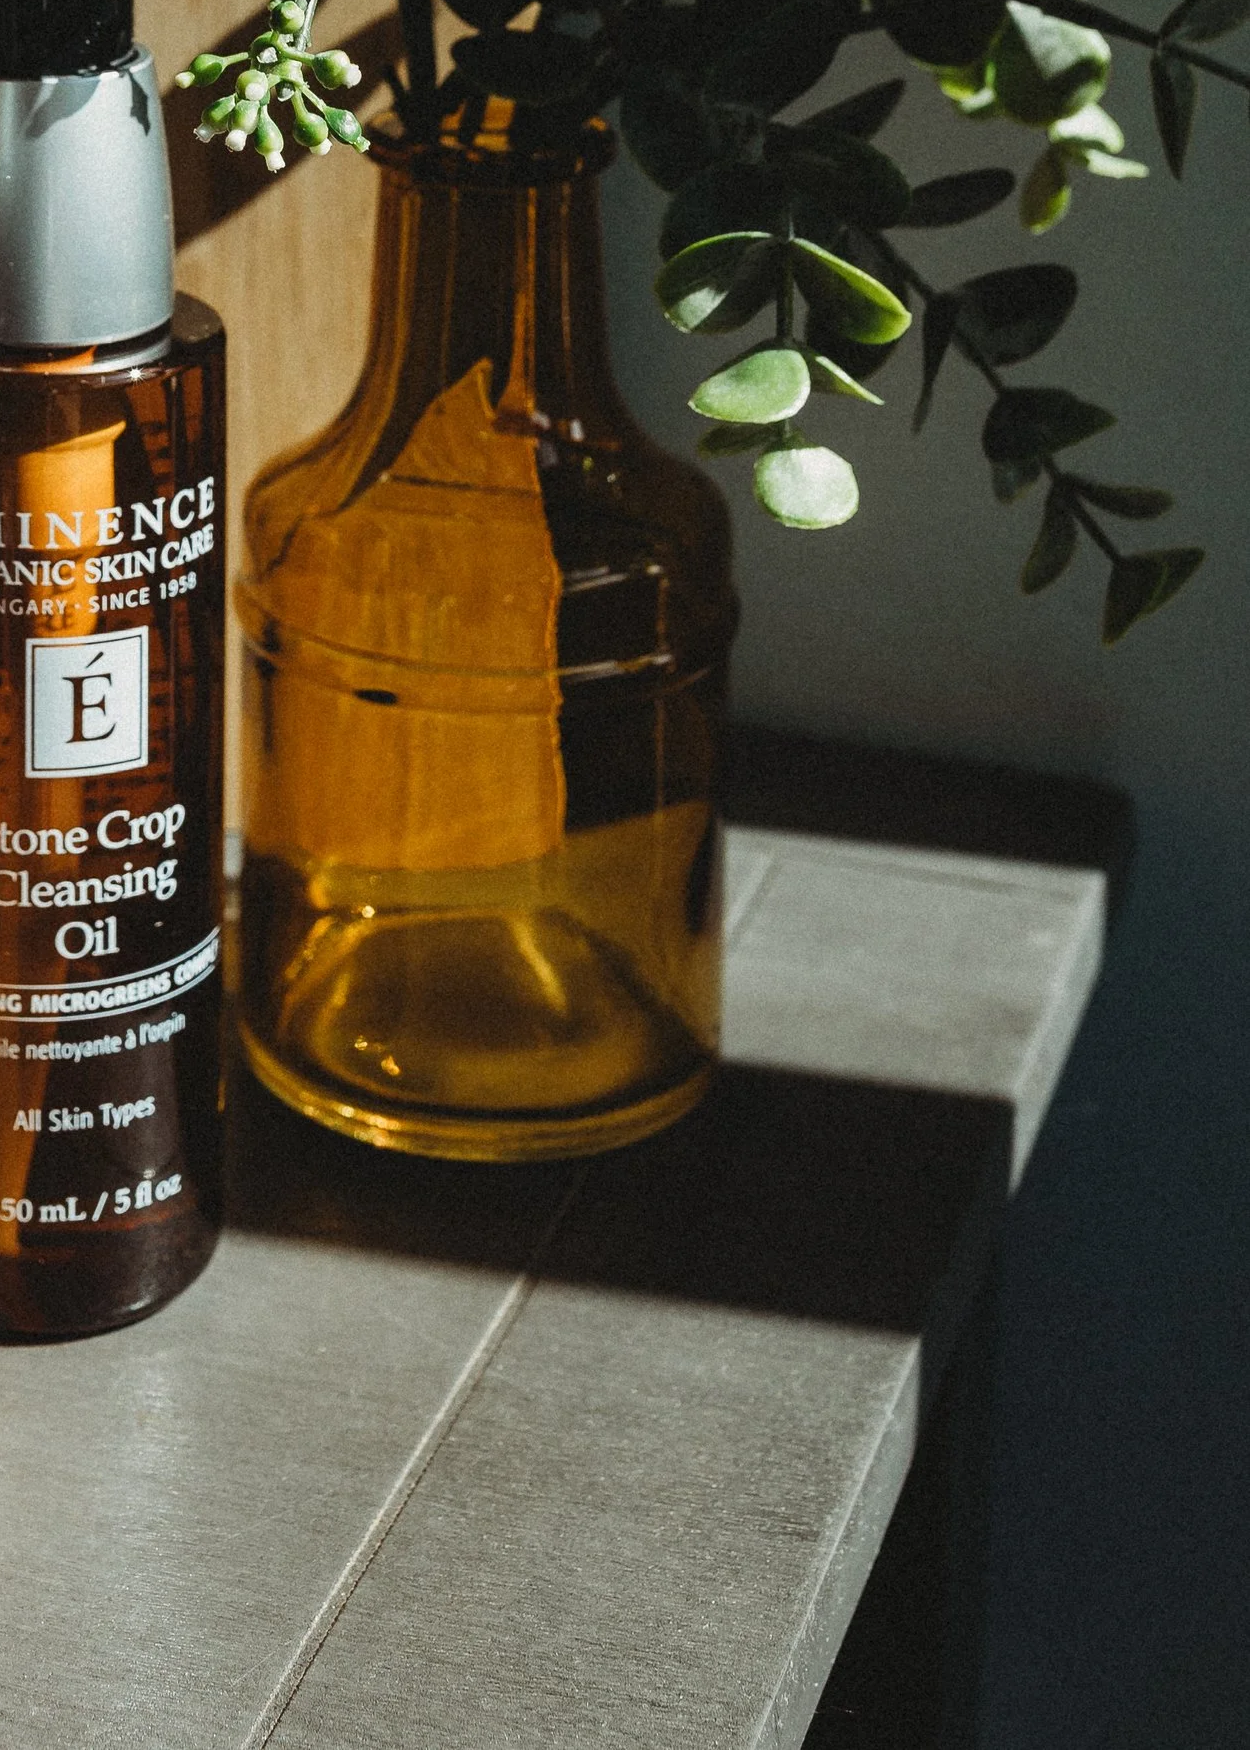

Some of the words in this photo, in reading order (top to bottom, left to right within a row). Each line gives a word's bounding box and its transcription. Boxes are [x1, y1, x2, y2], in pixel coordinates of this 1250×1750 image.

[84, 547, 156, 586] SKIN
[160, 522, 215, 570] CARE
[88, 587, 150, 614] SINCE
[159, 571, 198, 601] 1958
[61, 651, 117, 744] É
[97, 803, 187, 850] Crop
[54, 915, 120, 960] Oil
[30, 971, 171, 1014] MICROGREENS
[25, 1035, 122, 1063] nettoyante
[125, 1029, 137, 1050] à
[13, 1109, 41, 1132] All
[48, 1107, 94, 1132] Skin
[99, 1096, 156, 1130] Types
[39, 1196, 86, 1223] mL
[92, 1191, 109, 1223] /
[114, 1188, 130, 1216] 5
[155, 1173, 183, 1201] oz
